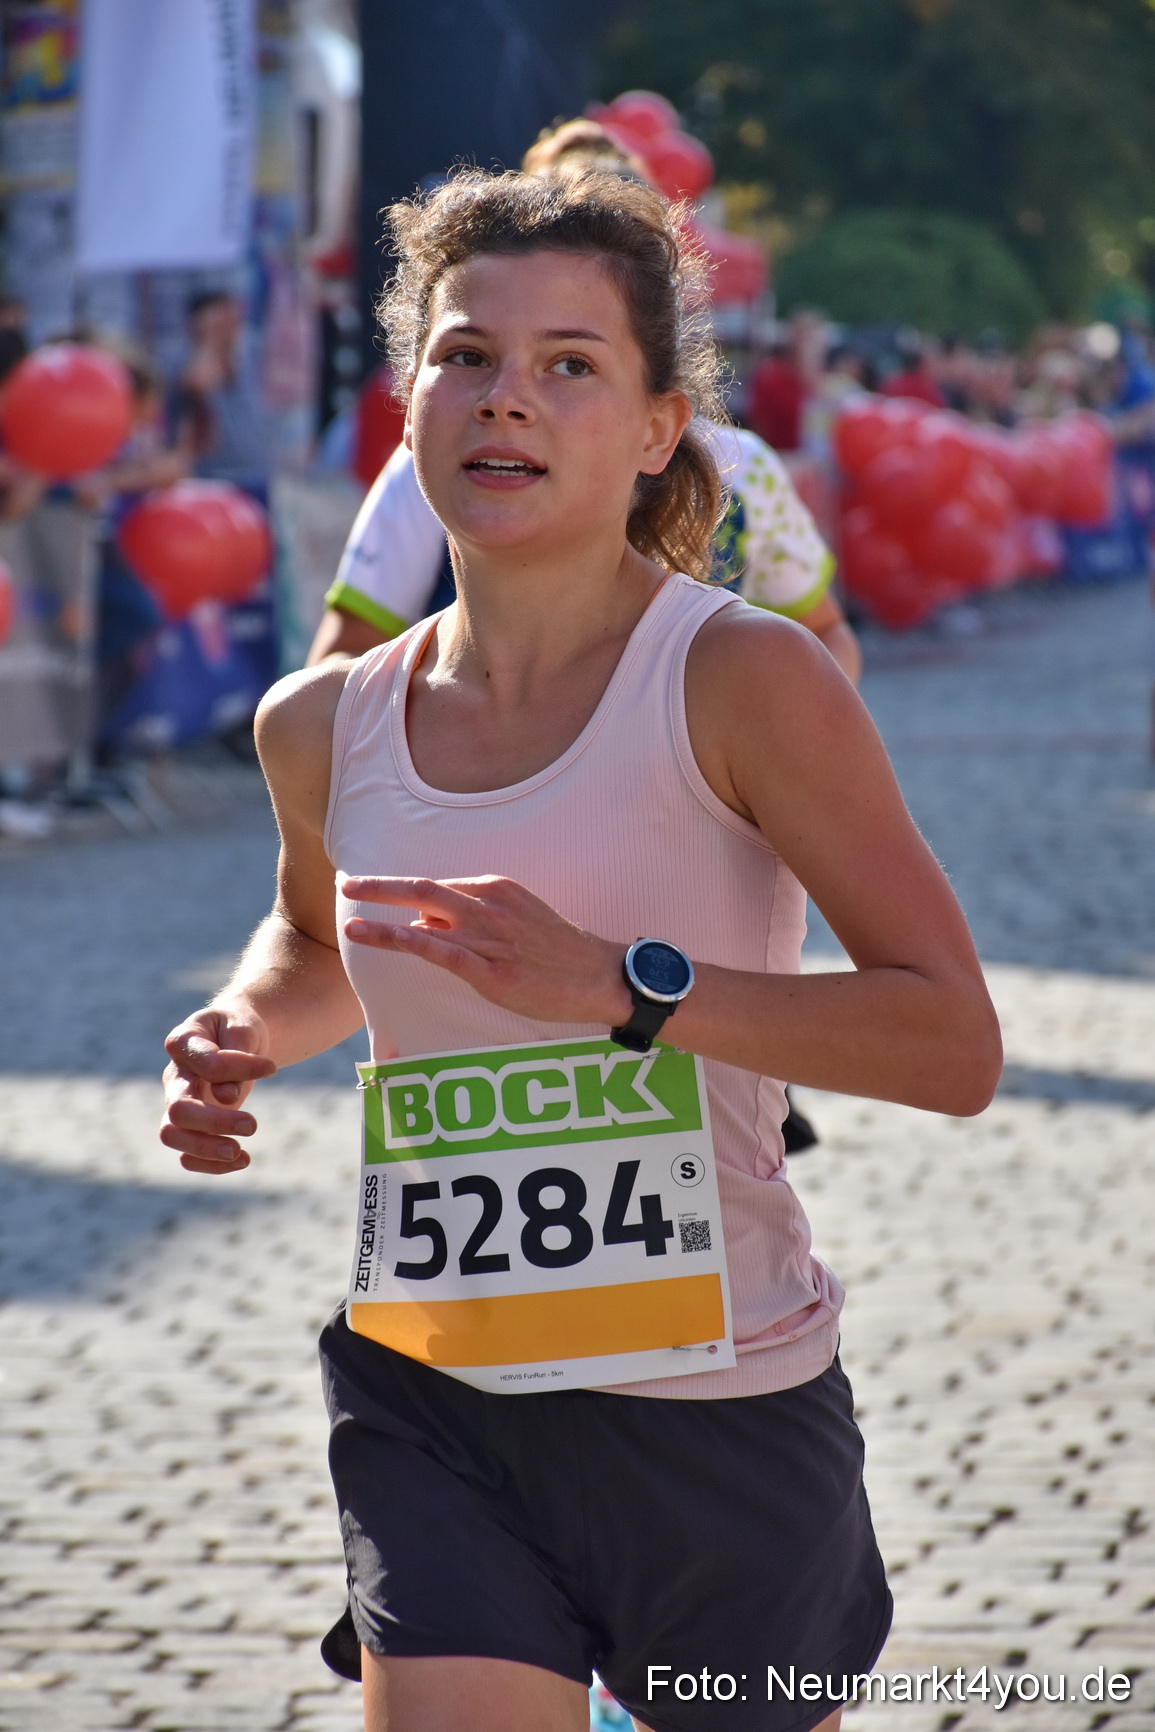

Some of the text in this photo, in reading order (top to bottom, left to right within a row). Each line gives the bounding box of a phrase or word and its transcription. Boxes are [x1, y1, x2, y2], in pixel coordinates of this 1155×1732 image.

[384, 1048, 675, 1150] BOCK
[680, 1161, 697, 1180] S
[393, 1159, 675, 1281] 5284
[373, 1235, 385, 1292] TRANSPONDER
[500, 1373, 523, 1381] HERVIS
[523, 1371, 547, 1380] FunRun
